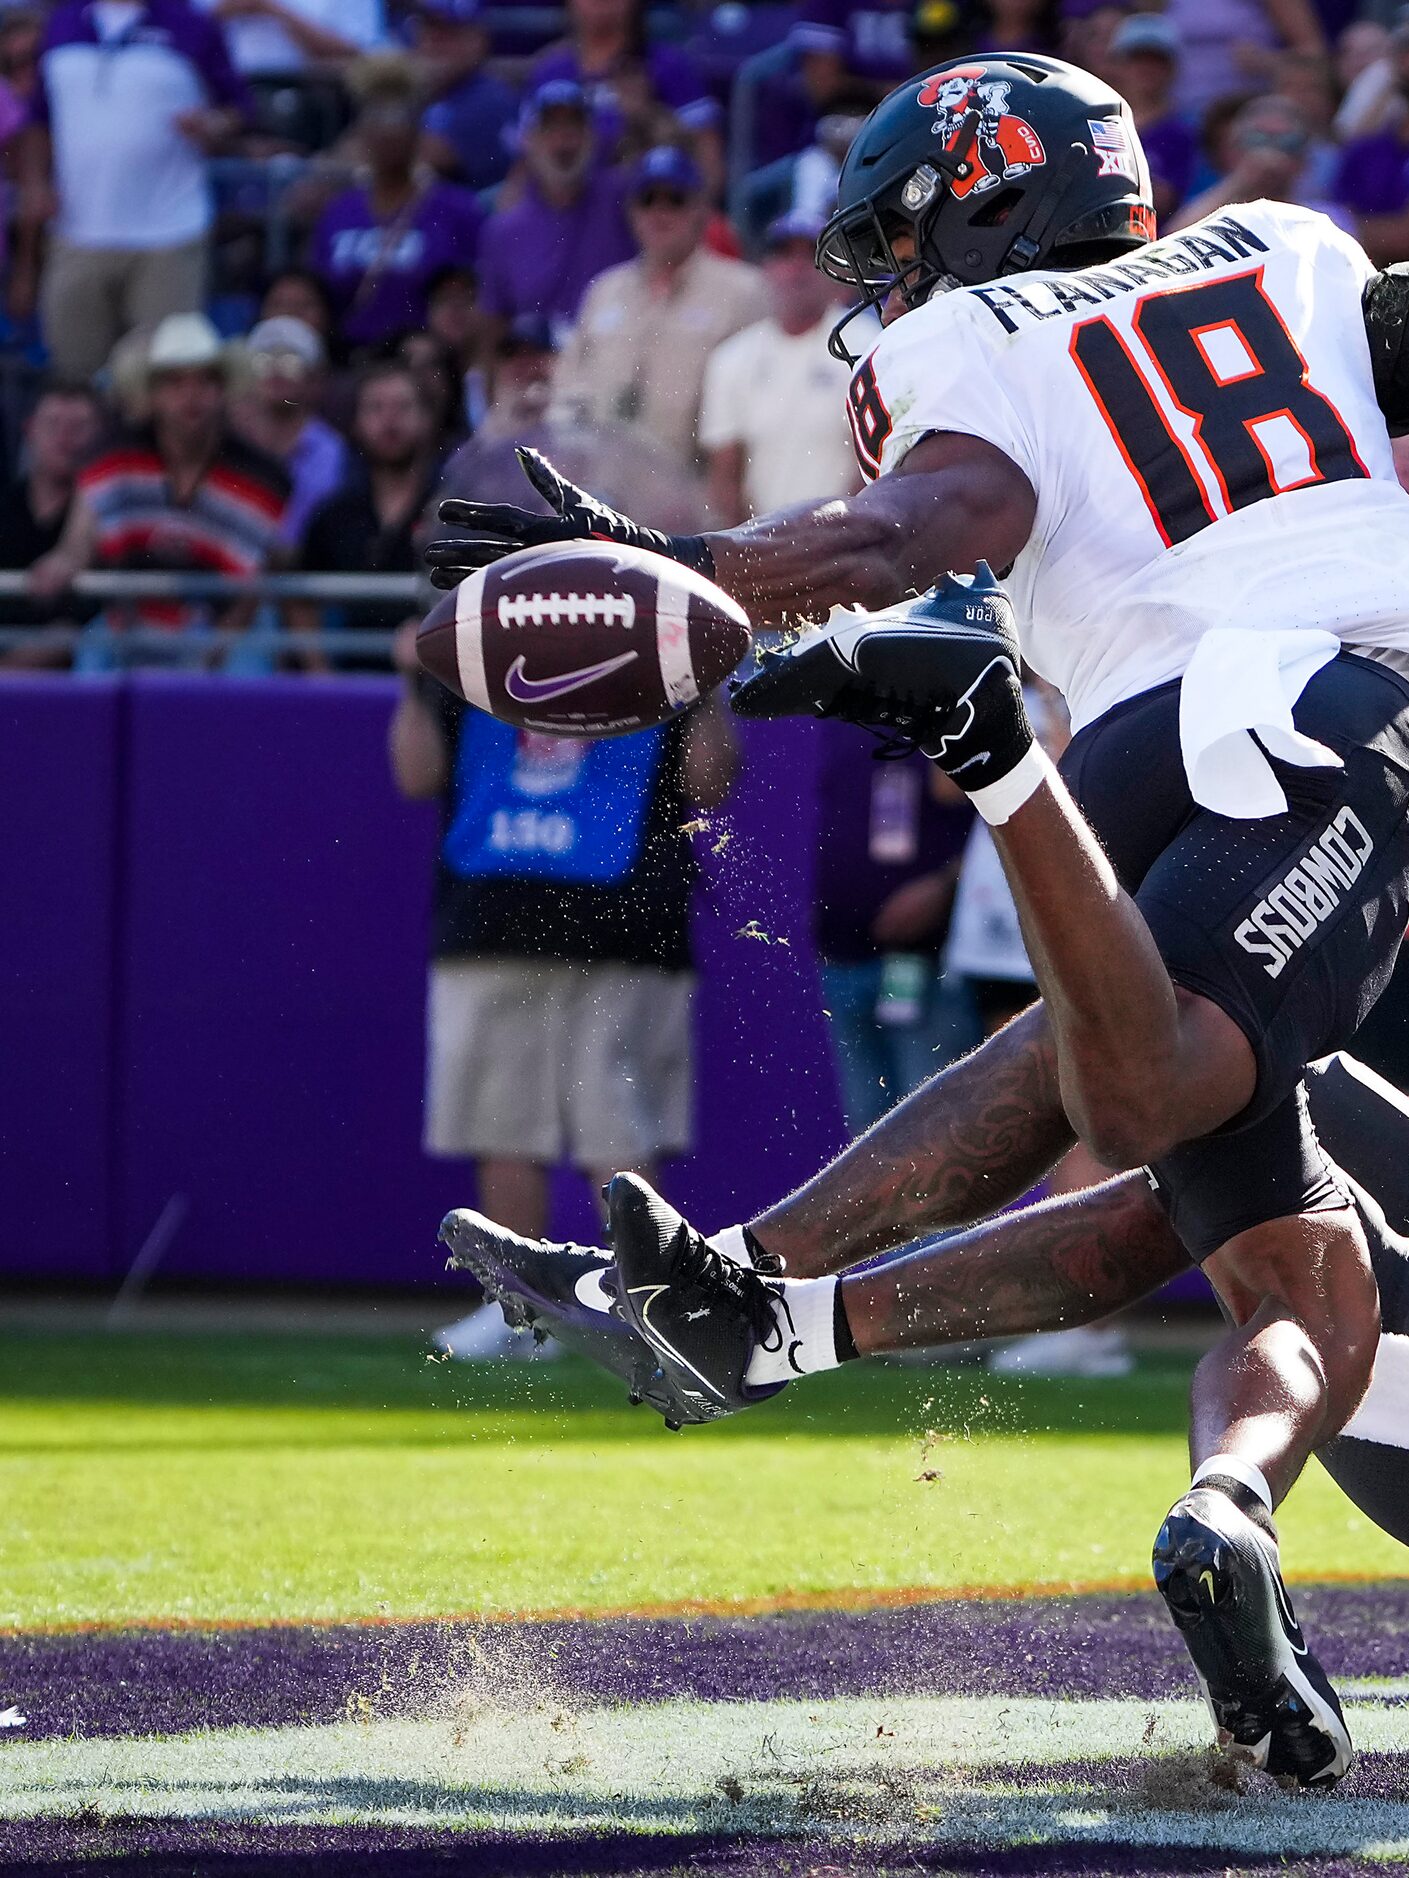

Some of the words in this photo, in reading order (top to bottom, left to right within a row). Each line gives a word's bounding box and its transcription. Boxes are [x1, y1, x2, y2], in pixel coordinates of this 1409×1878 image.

[1017, 126, 1041, 160] OSU
[968, 215, 1271, 335] FLANAGAN
[1067, 263, 1372, 550] 18
[1233, 805, 1374, 979] COWBOYS
